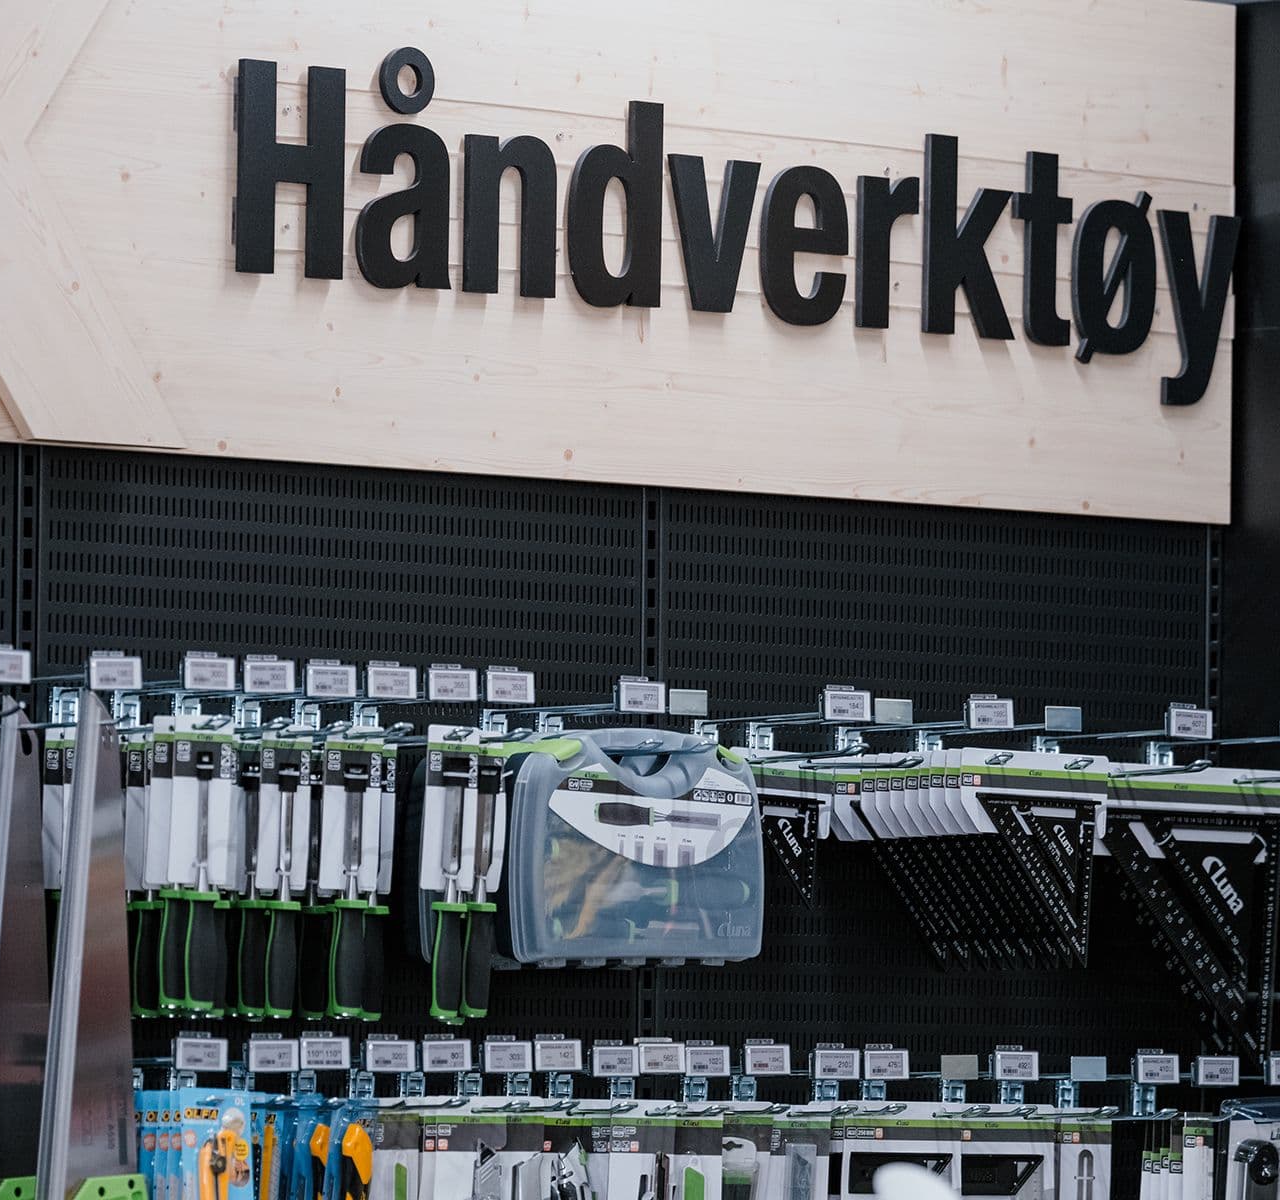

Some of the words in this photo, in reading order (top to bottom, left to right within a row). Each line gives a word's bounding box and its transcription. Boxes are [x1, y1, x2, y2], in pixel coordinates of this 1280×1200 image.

[232, 46, 1241, 407] Håndverktøy
[777, 818, 802, 857] Luna
[1053, 825, 1074, 856] Luna
[1202, 856, 1244, 915] Luna
[184, 1108, 218, 1121] OLFA
